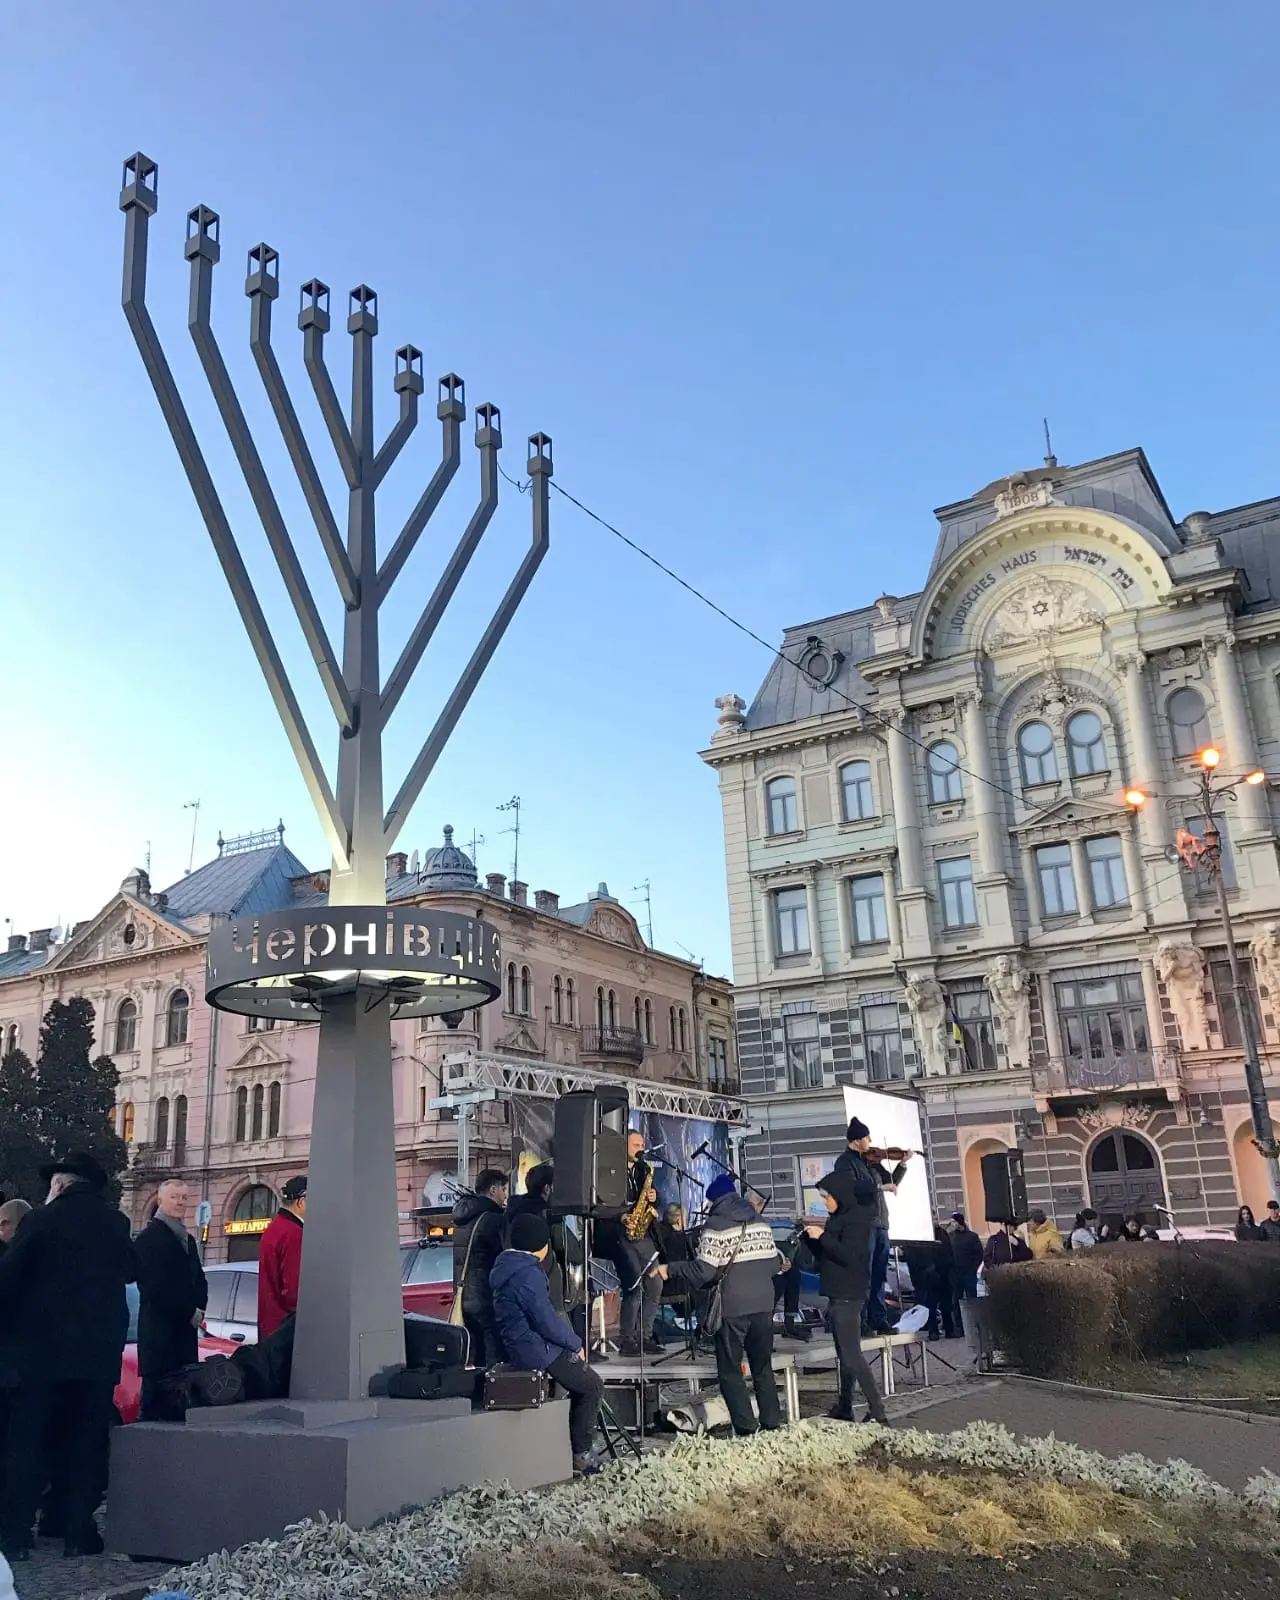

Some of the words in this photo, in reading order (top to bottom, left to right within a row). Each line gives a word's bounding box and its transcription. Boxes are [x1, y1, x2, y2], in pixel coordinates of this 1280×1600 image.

[1001, 550, 1037, 573] HAUS
[1064, 546, 1107, 566] ישראל
[1110, 567, 1134, 589] בית
